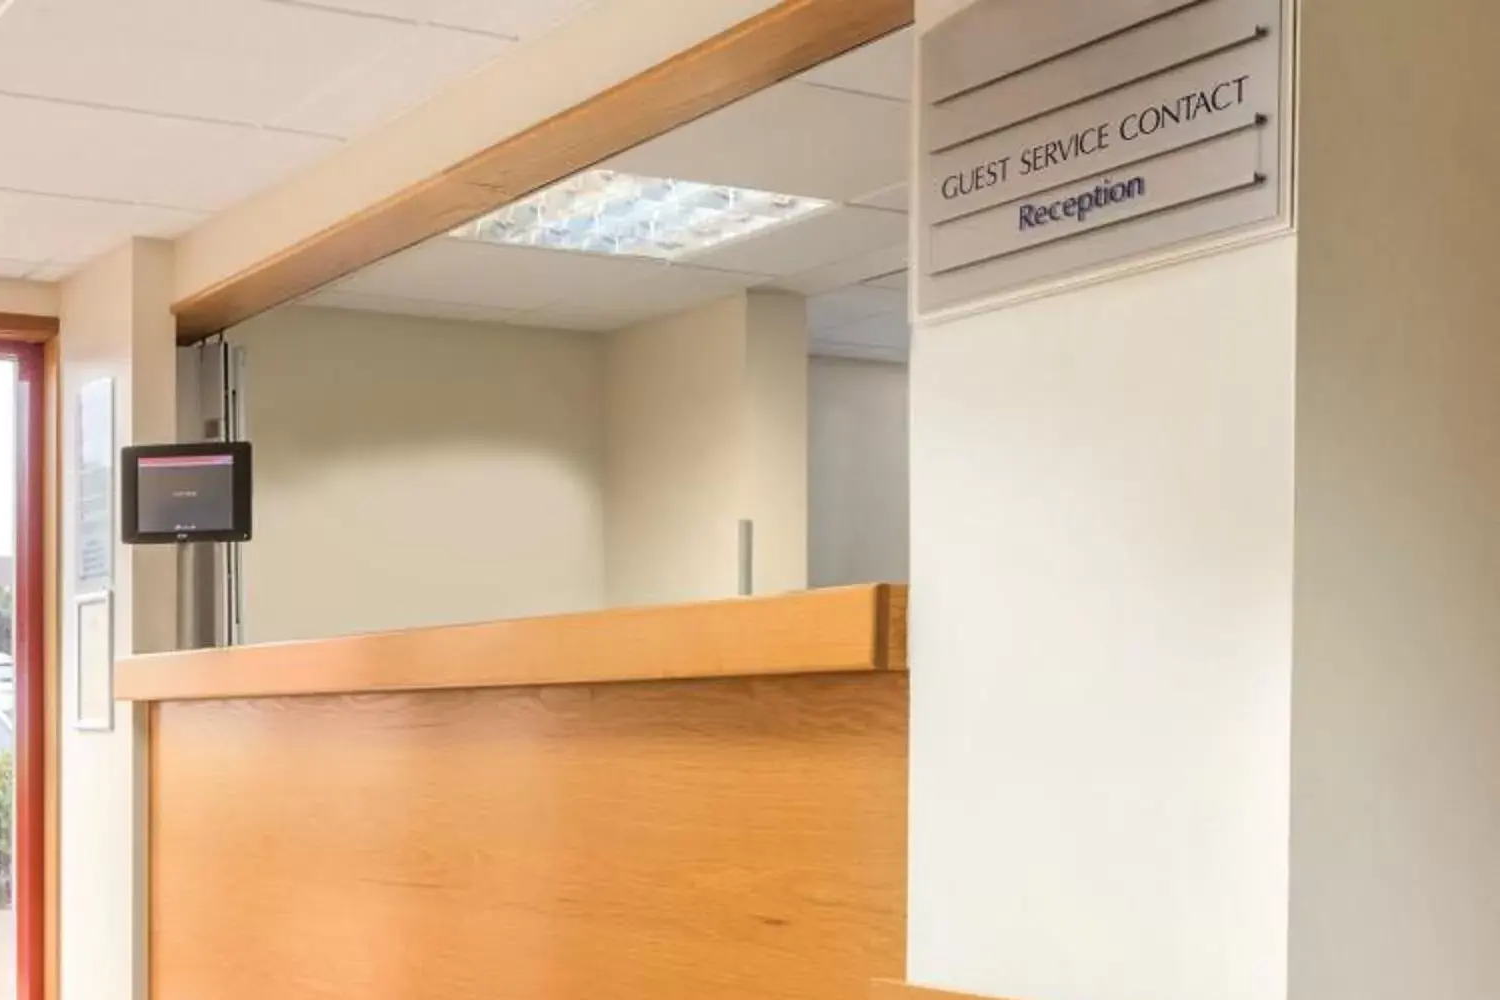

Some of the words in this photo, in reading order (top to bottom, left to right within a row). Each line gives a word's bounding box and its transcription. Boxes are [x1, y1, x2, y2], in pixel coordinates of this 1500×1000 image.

[941, 158, 1010, 199] GUEST
[1020, 124, 1110, 175] SERVICE
[1120, 76, 1249, 141] CONTACT
[1019, 176, 1145, 230] Reception
